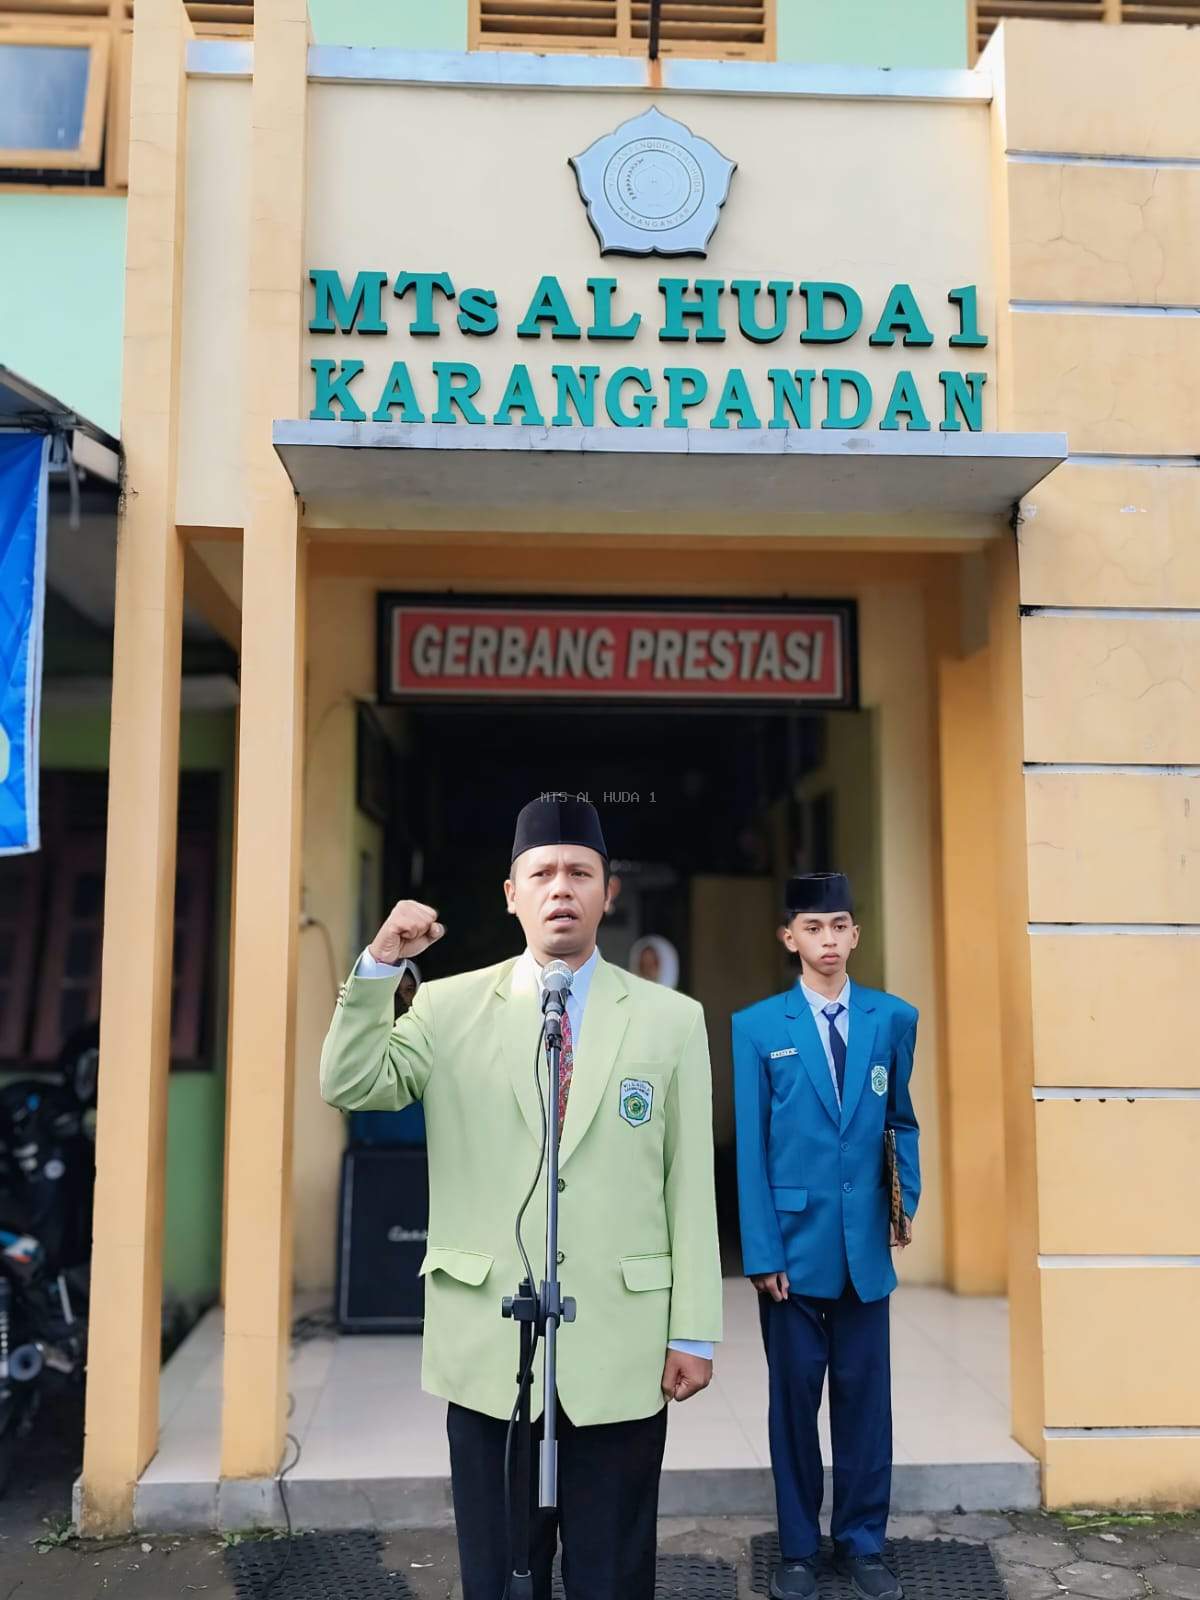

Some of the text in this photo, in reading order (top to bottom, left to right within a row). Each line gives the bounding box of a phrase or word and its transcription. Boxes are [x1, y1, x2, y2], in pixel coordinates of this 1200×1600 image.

[309, 269, 988, 348] MTs AL HUDA 1
[310, 359, 987, 432] KARANGPANDAN
[412, 623, 825, 682] GERBANG PRESTASI
